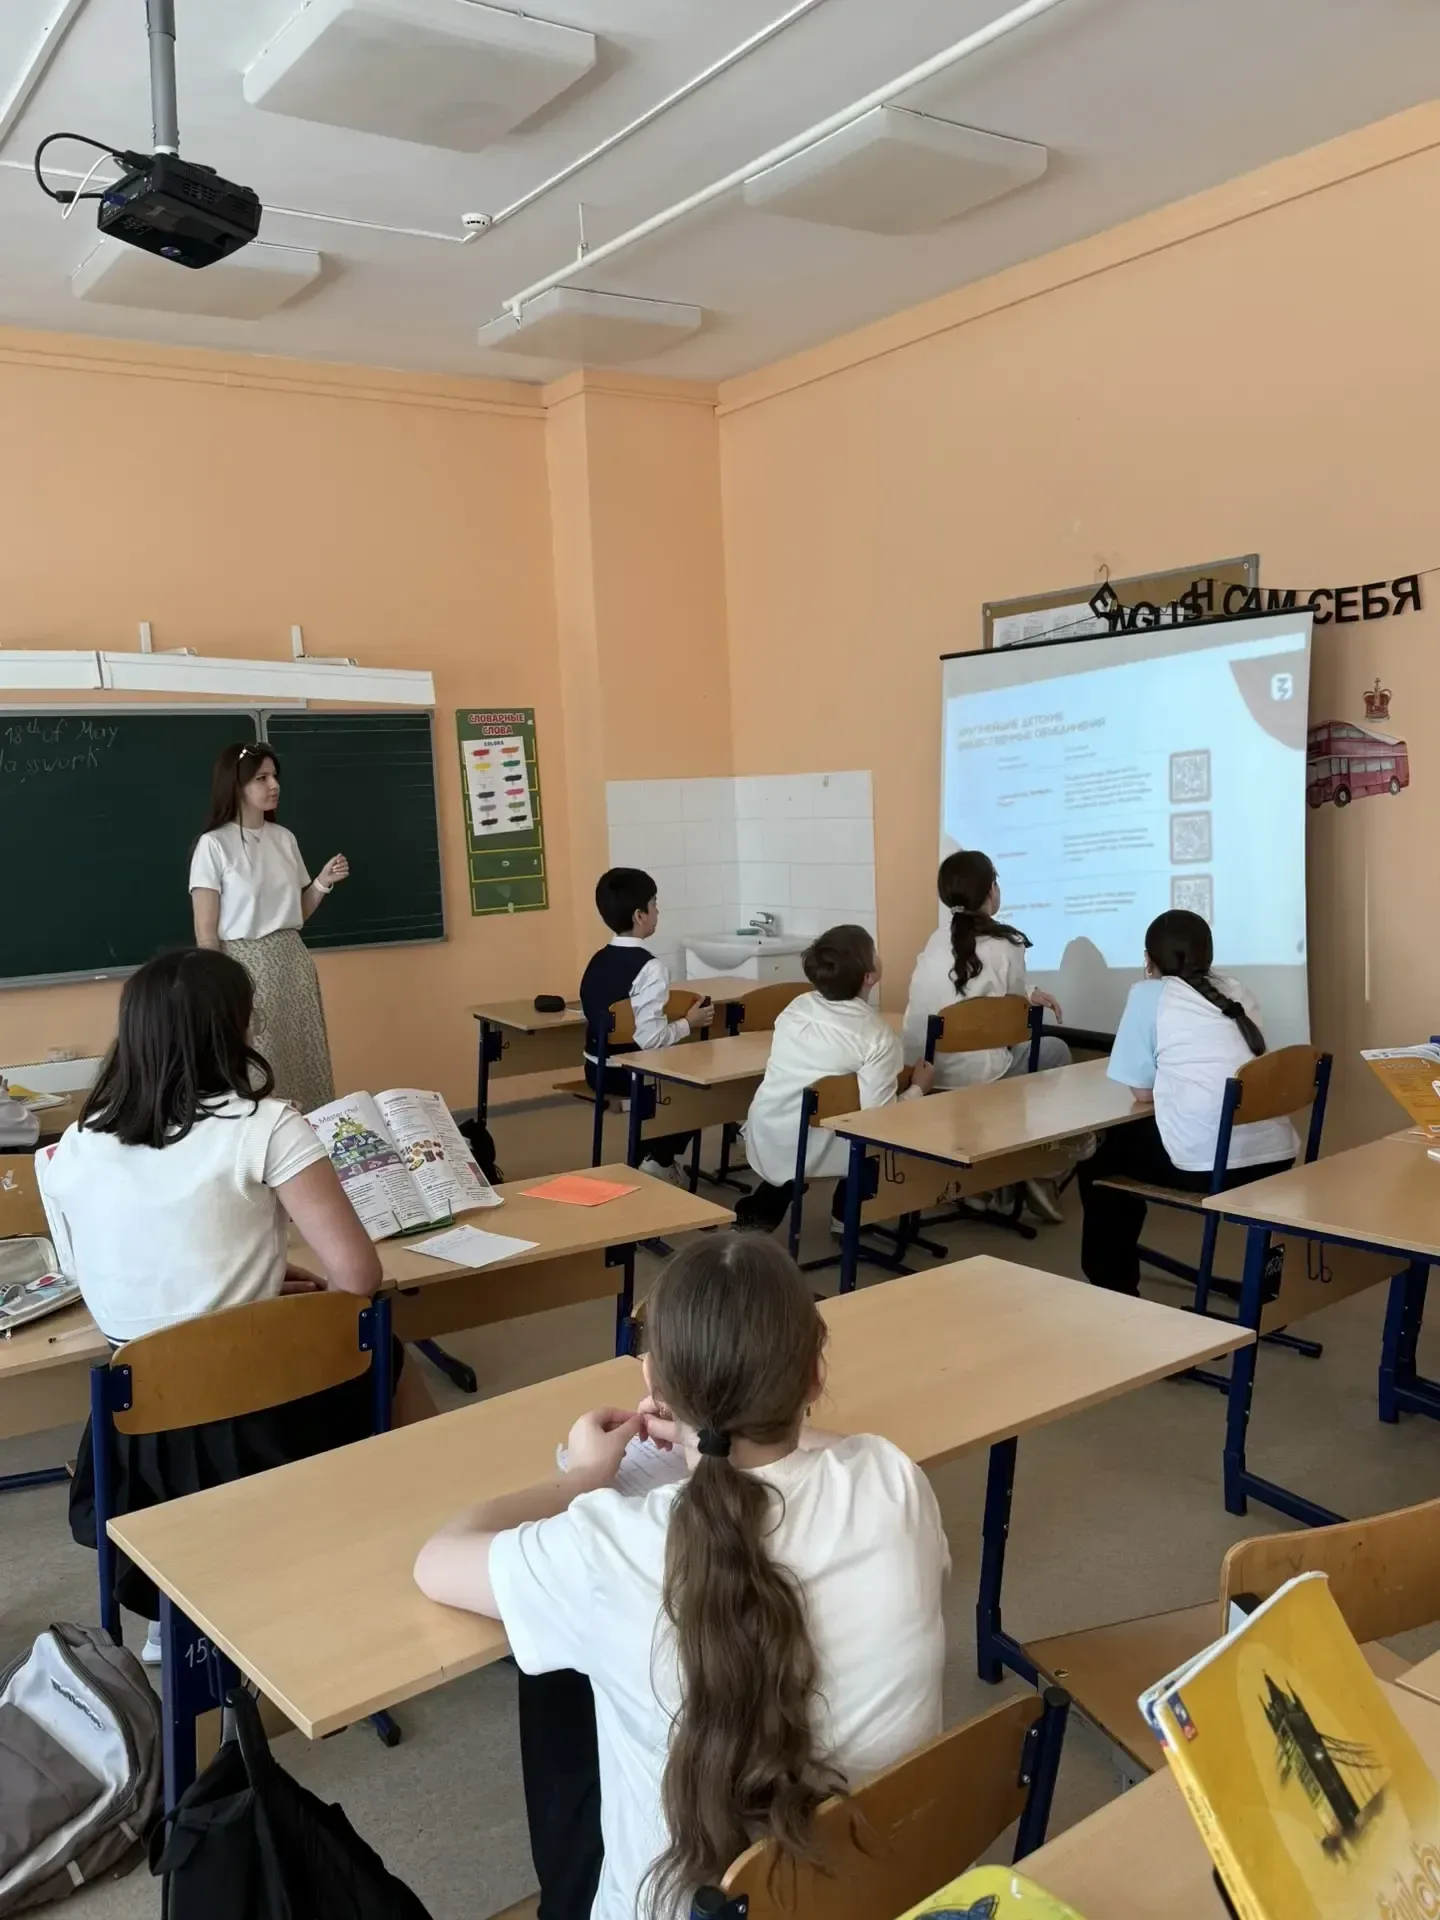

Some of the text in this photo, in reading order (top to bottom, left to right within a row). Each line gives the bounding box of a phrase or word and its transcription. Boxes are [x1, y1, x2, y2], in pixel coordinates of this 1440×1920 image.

[1223, 574, 1422, 625] САМ СЕБЯ
[42, 717, 68, 743] of
[76, 720, 120, 748] May
[468, 712, 525, 724] СЛОВАРНЫЕ
[482, 725, 514, 736] СЛОВА
[0, 744, 100, 774] lasswork
